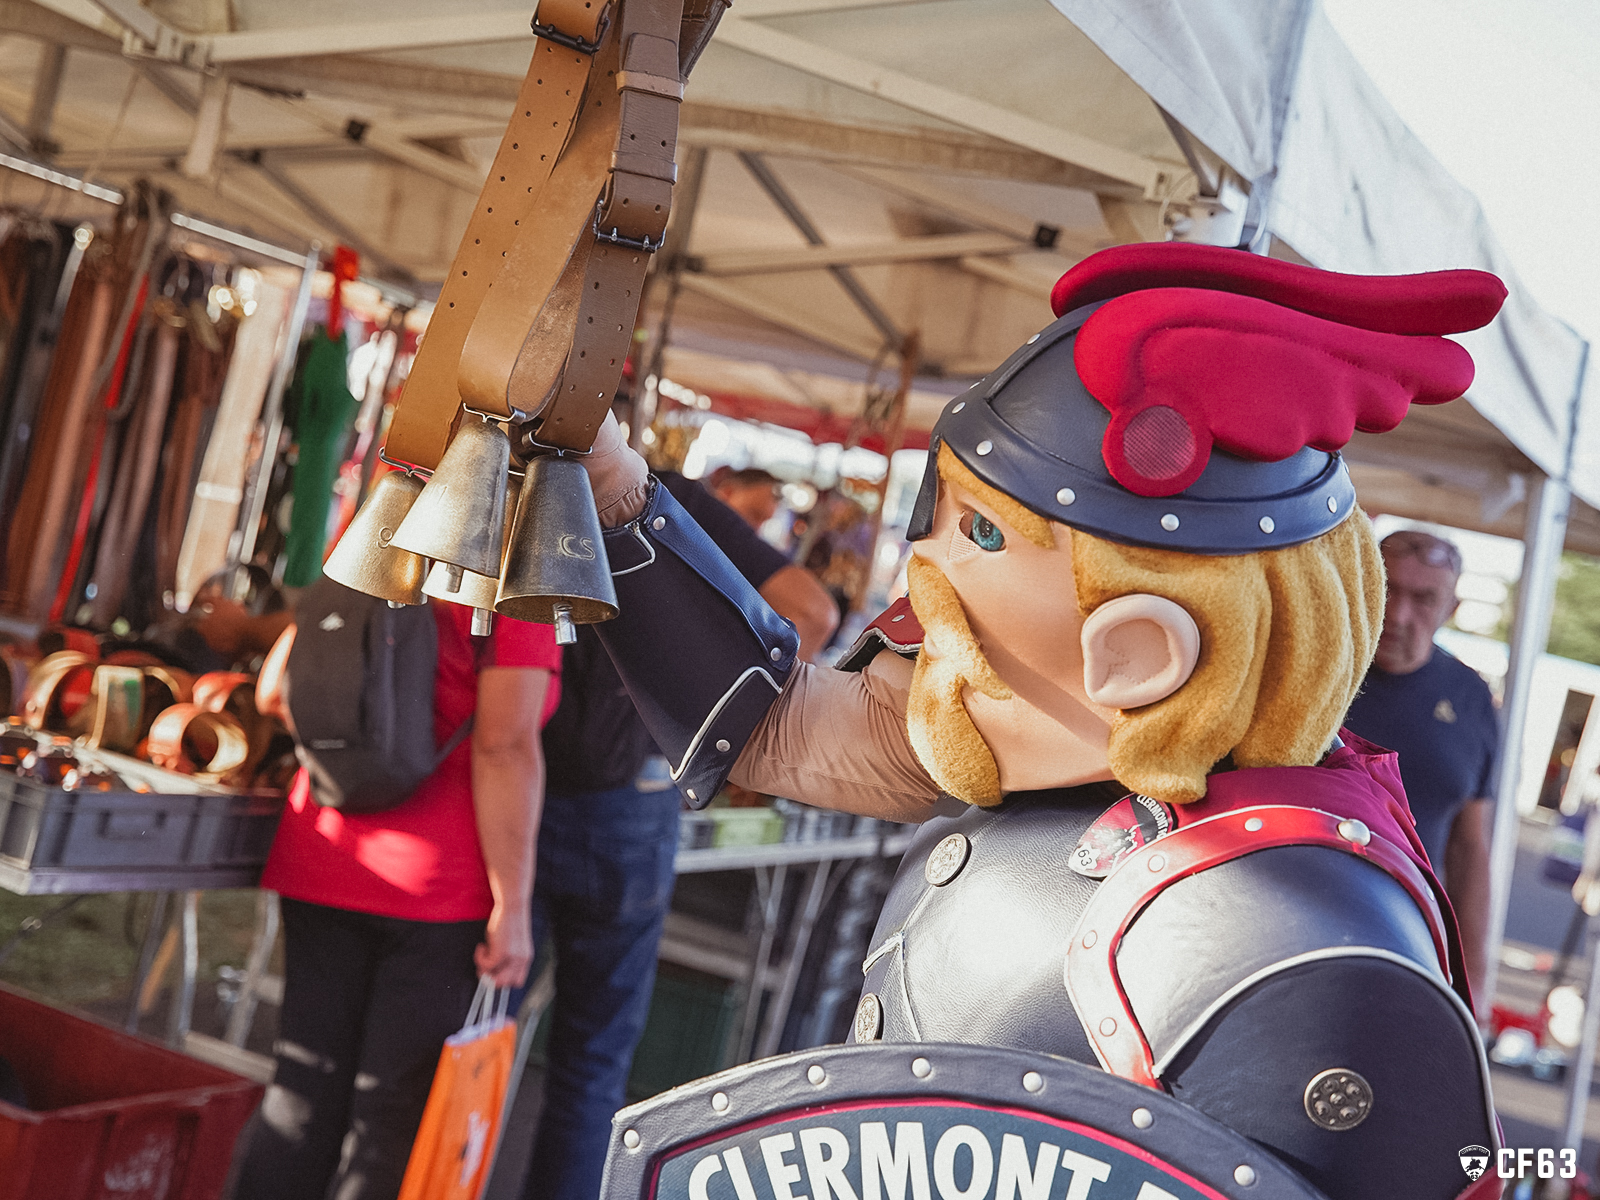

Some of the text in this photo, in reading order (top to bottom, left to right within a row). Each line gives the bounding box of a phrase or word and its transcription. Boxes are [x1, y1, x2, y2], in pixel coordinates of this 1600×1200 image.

[558, 533, 597, 561] CS
[1136, 794, 1168, 830] CLERMONT
[1077, 849, 1093, 867] 63
